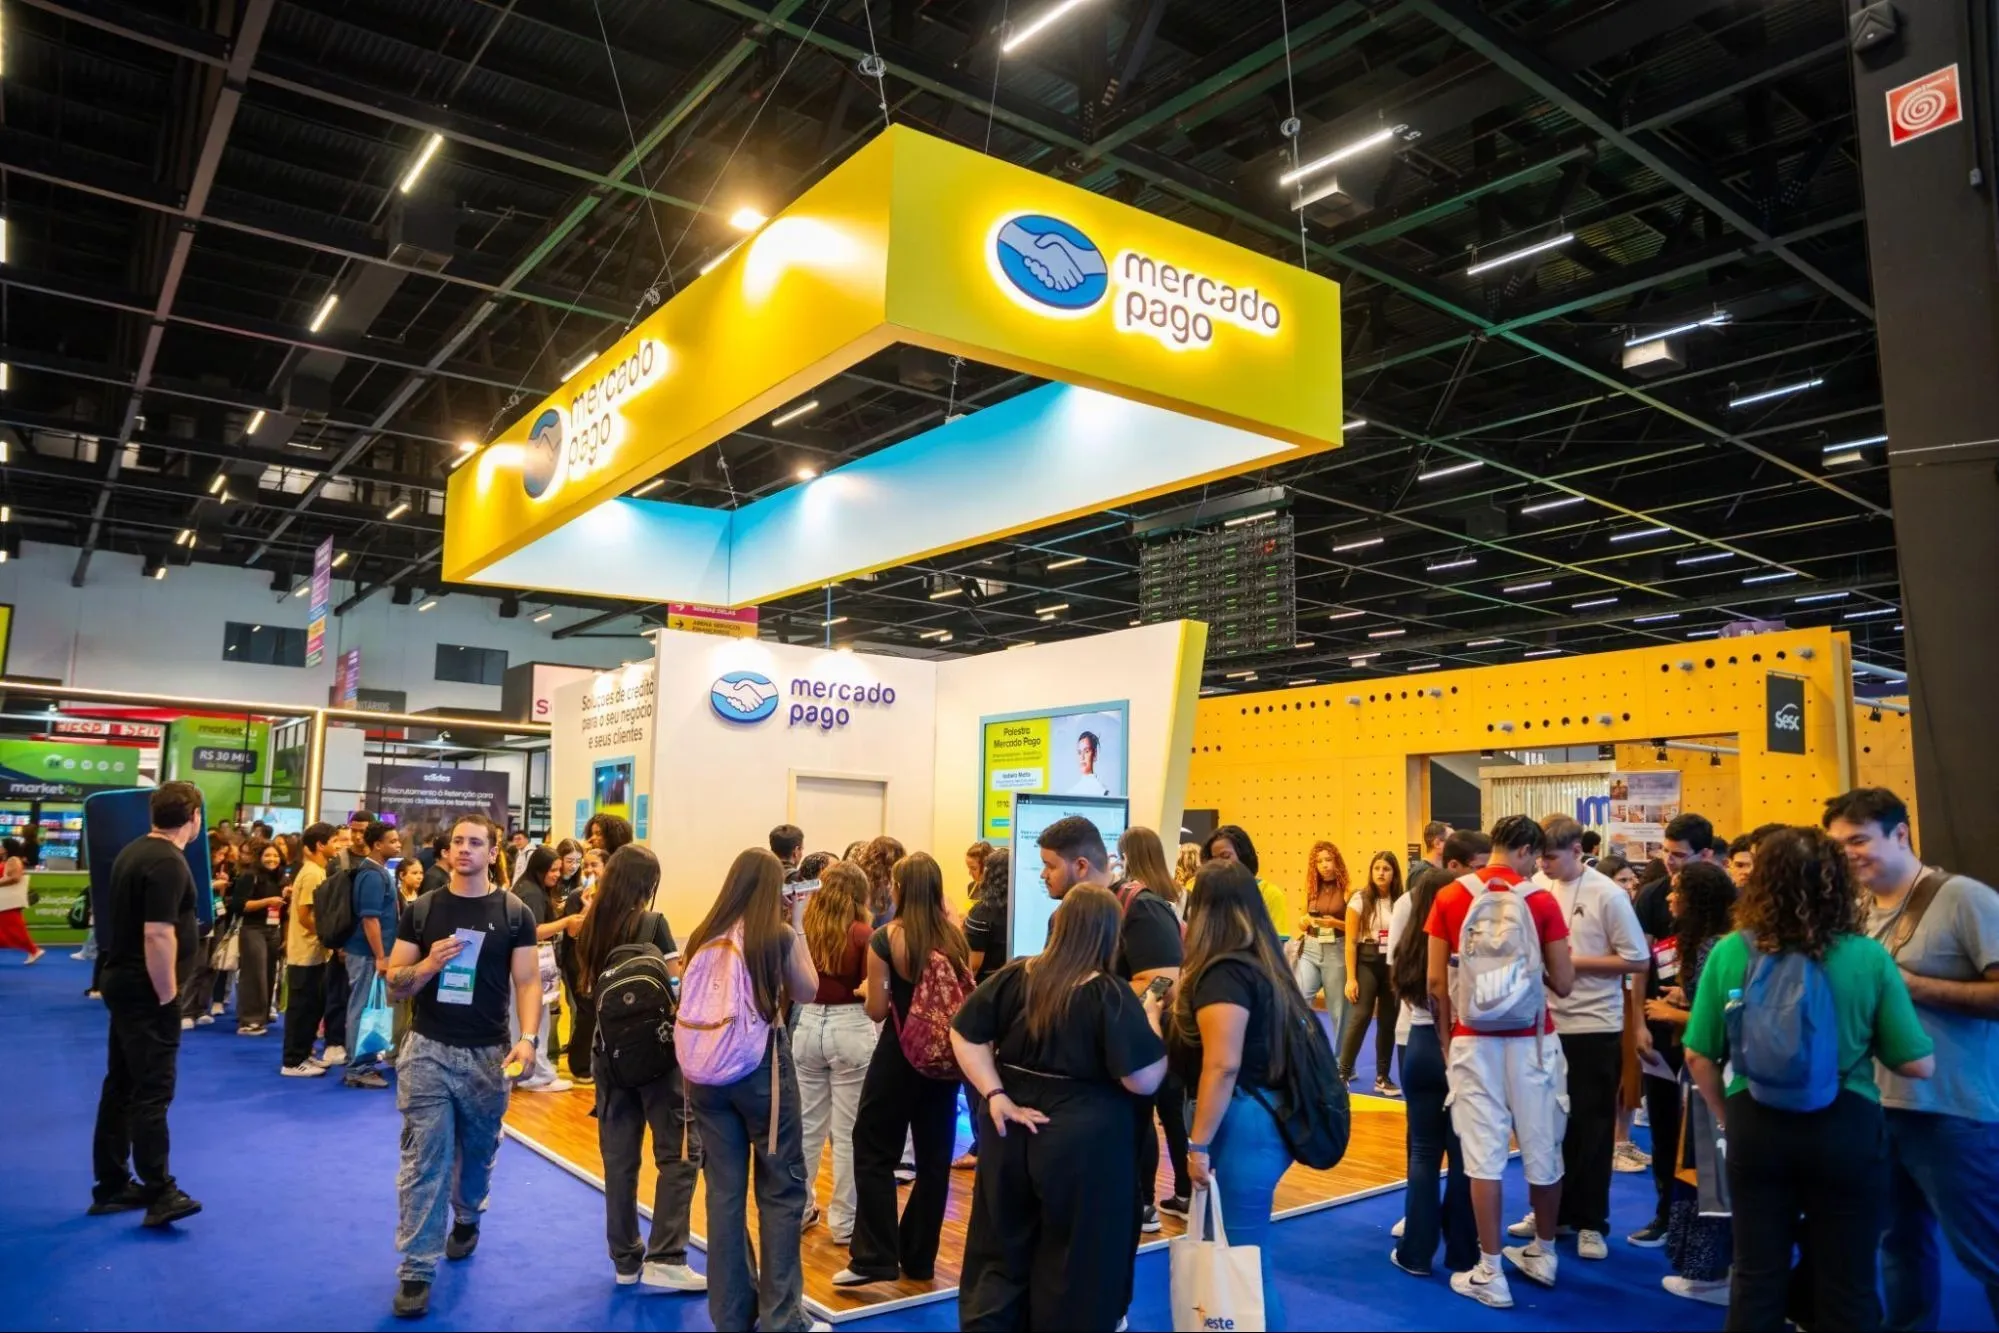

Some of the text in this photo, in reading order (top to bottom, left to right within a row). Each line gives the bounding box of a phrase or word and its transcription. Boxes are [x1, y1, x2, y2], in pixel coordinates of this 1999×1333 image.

[1125, 252, 1281, 329] mercado
[1125, 291, 1213, 344] pago
[570, 339, 654, 430] mercado
[567, 412, 611, 473] pago
[582, 690, 615, 712] Soções
[790, 678, 896, 705] mercado
[600, 714, 604, 727] o
[606, 711, 619, 726] seu
[789, 703, 850, 730] pago
[588, 725, 644, 749] e seus clientes
[993, 736, 1041, 749] Mercado Pago
[215, 751, 229, 761] 30
[1475, 956, 1528, 1005] NIKE
[1203, 1317, 1235, 1331] este
